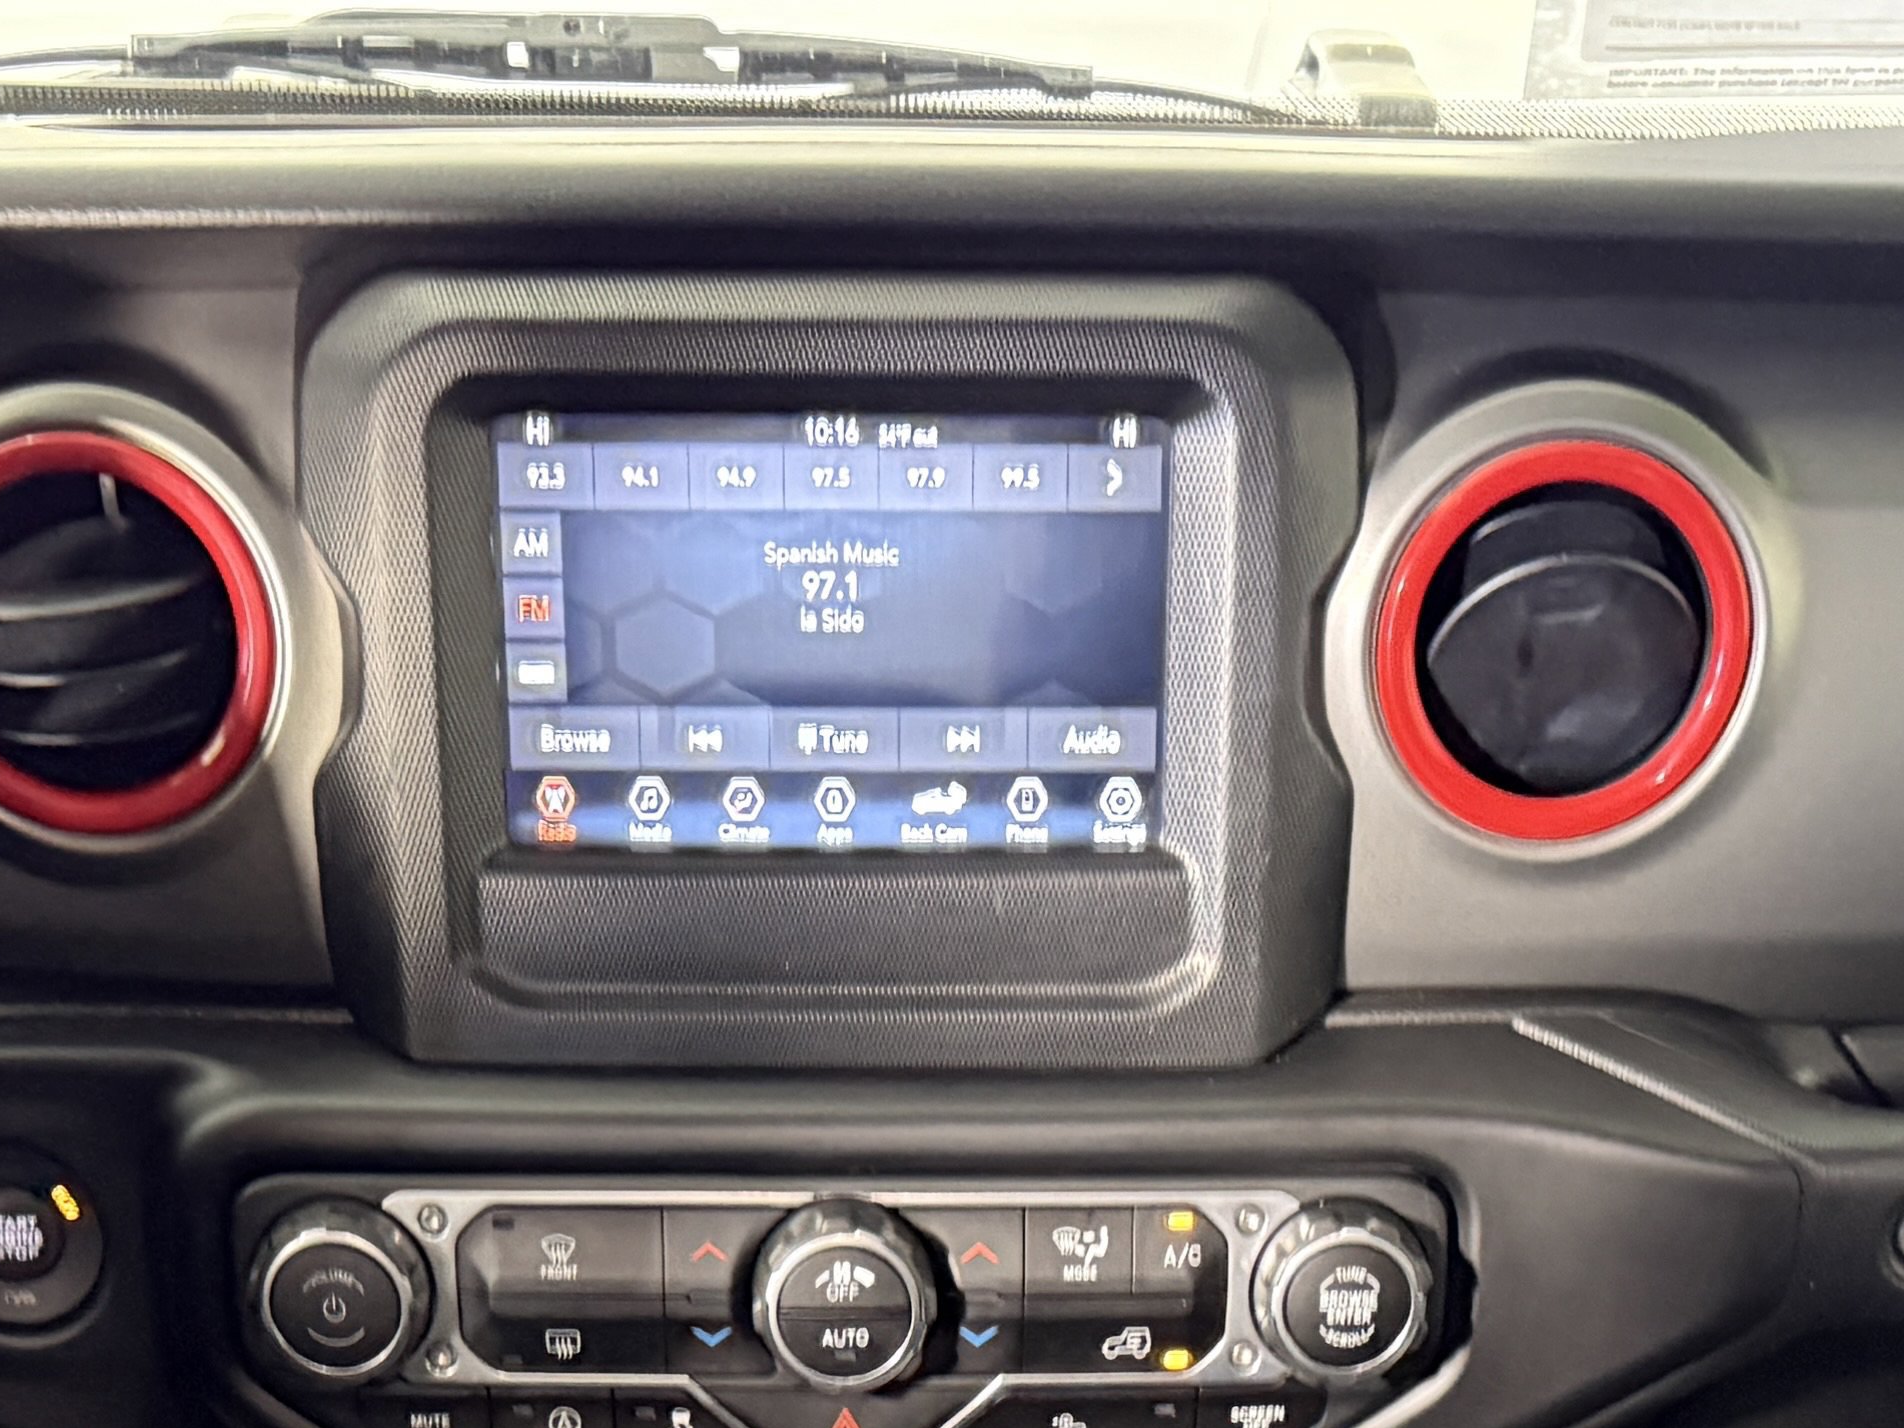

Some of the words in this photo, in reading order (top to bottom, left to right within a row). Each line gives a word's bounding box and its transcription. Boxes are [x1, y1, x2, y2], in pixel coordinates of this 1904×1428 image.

[804, 416, 860, 447] 10:16
[513, 528, 549, 558] AM
[764, 539, 839, 571] Spanish
[843, 538, 900, 567] Music
[801, 570, 858, 602] 97.1
[518, 594, 552, 623] FM
[1062, 723, 1122, 755] Audio
[826, 1281, 860, 1304] OFF
[822, 1326, 870, 1349] AUTO
